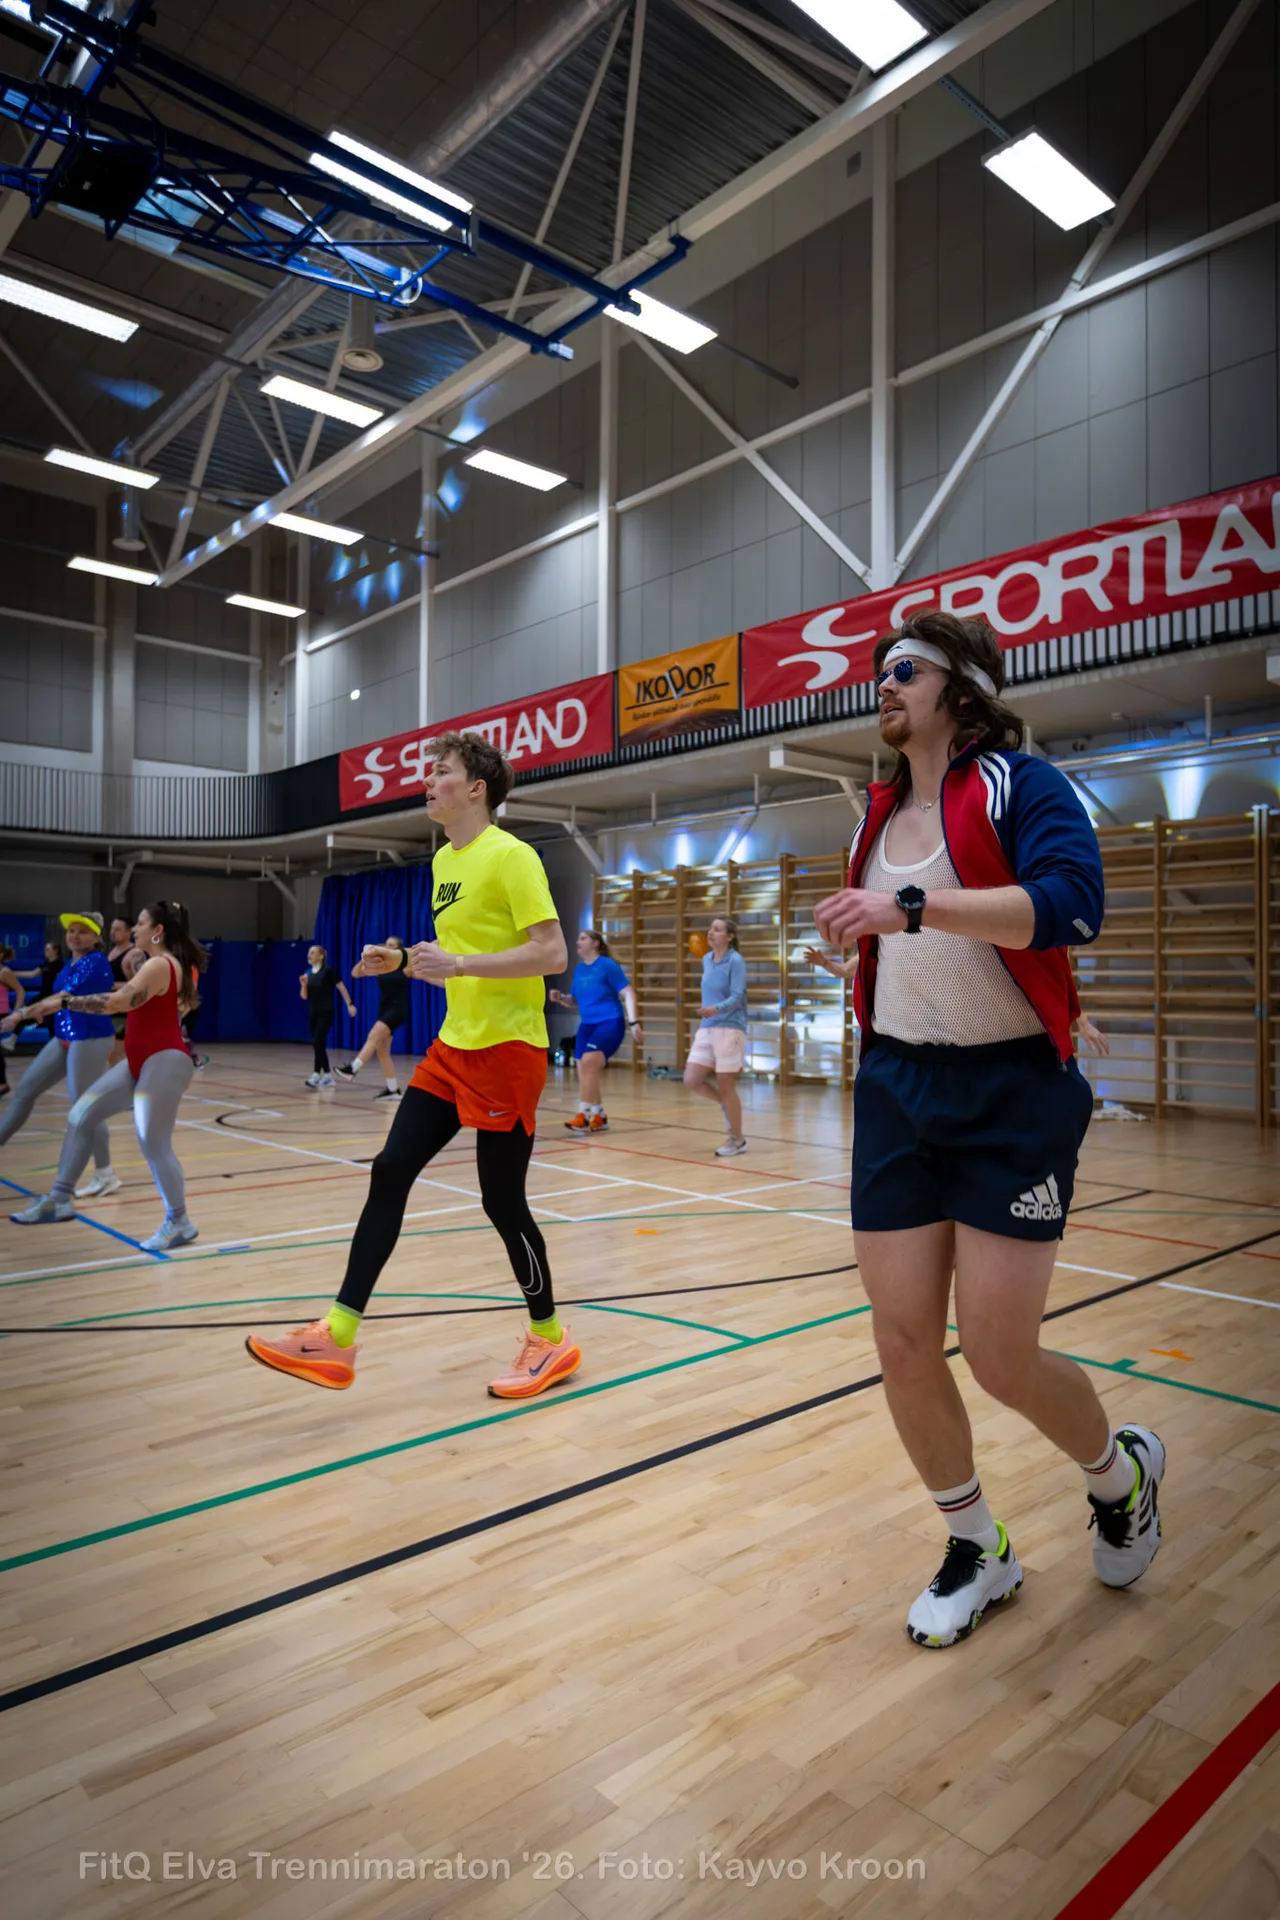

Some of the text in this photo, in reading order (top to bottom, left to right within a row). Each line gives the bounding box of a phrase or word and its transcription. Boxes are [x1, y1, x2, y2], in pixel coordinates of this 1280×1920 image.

[890, 491, 1280, 636] PORTLA
[635, 662, 717, 704] IKODOR
[399, 698, 588, 786] SPTLAND
[435, 881, 463, 903] RUN
[1009, 1200, 1063, 1221] adidas
